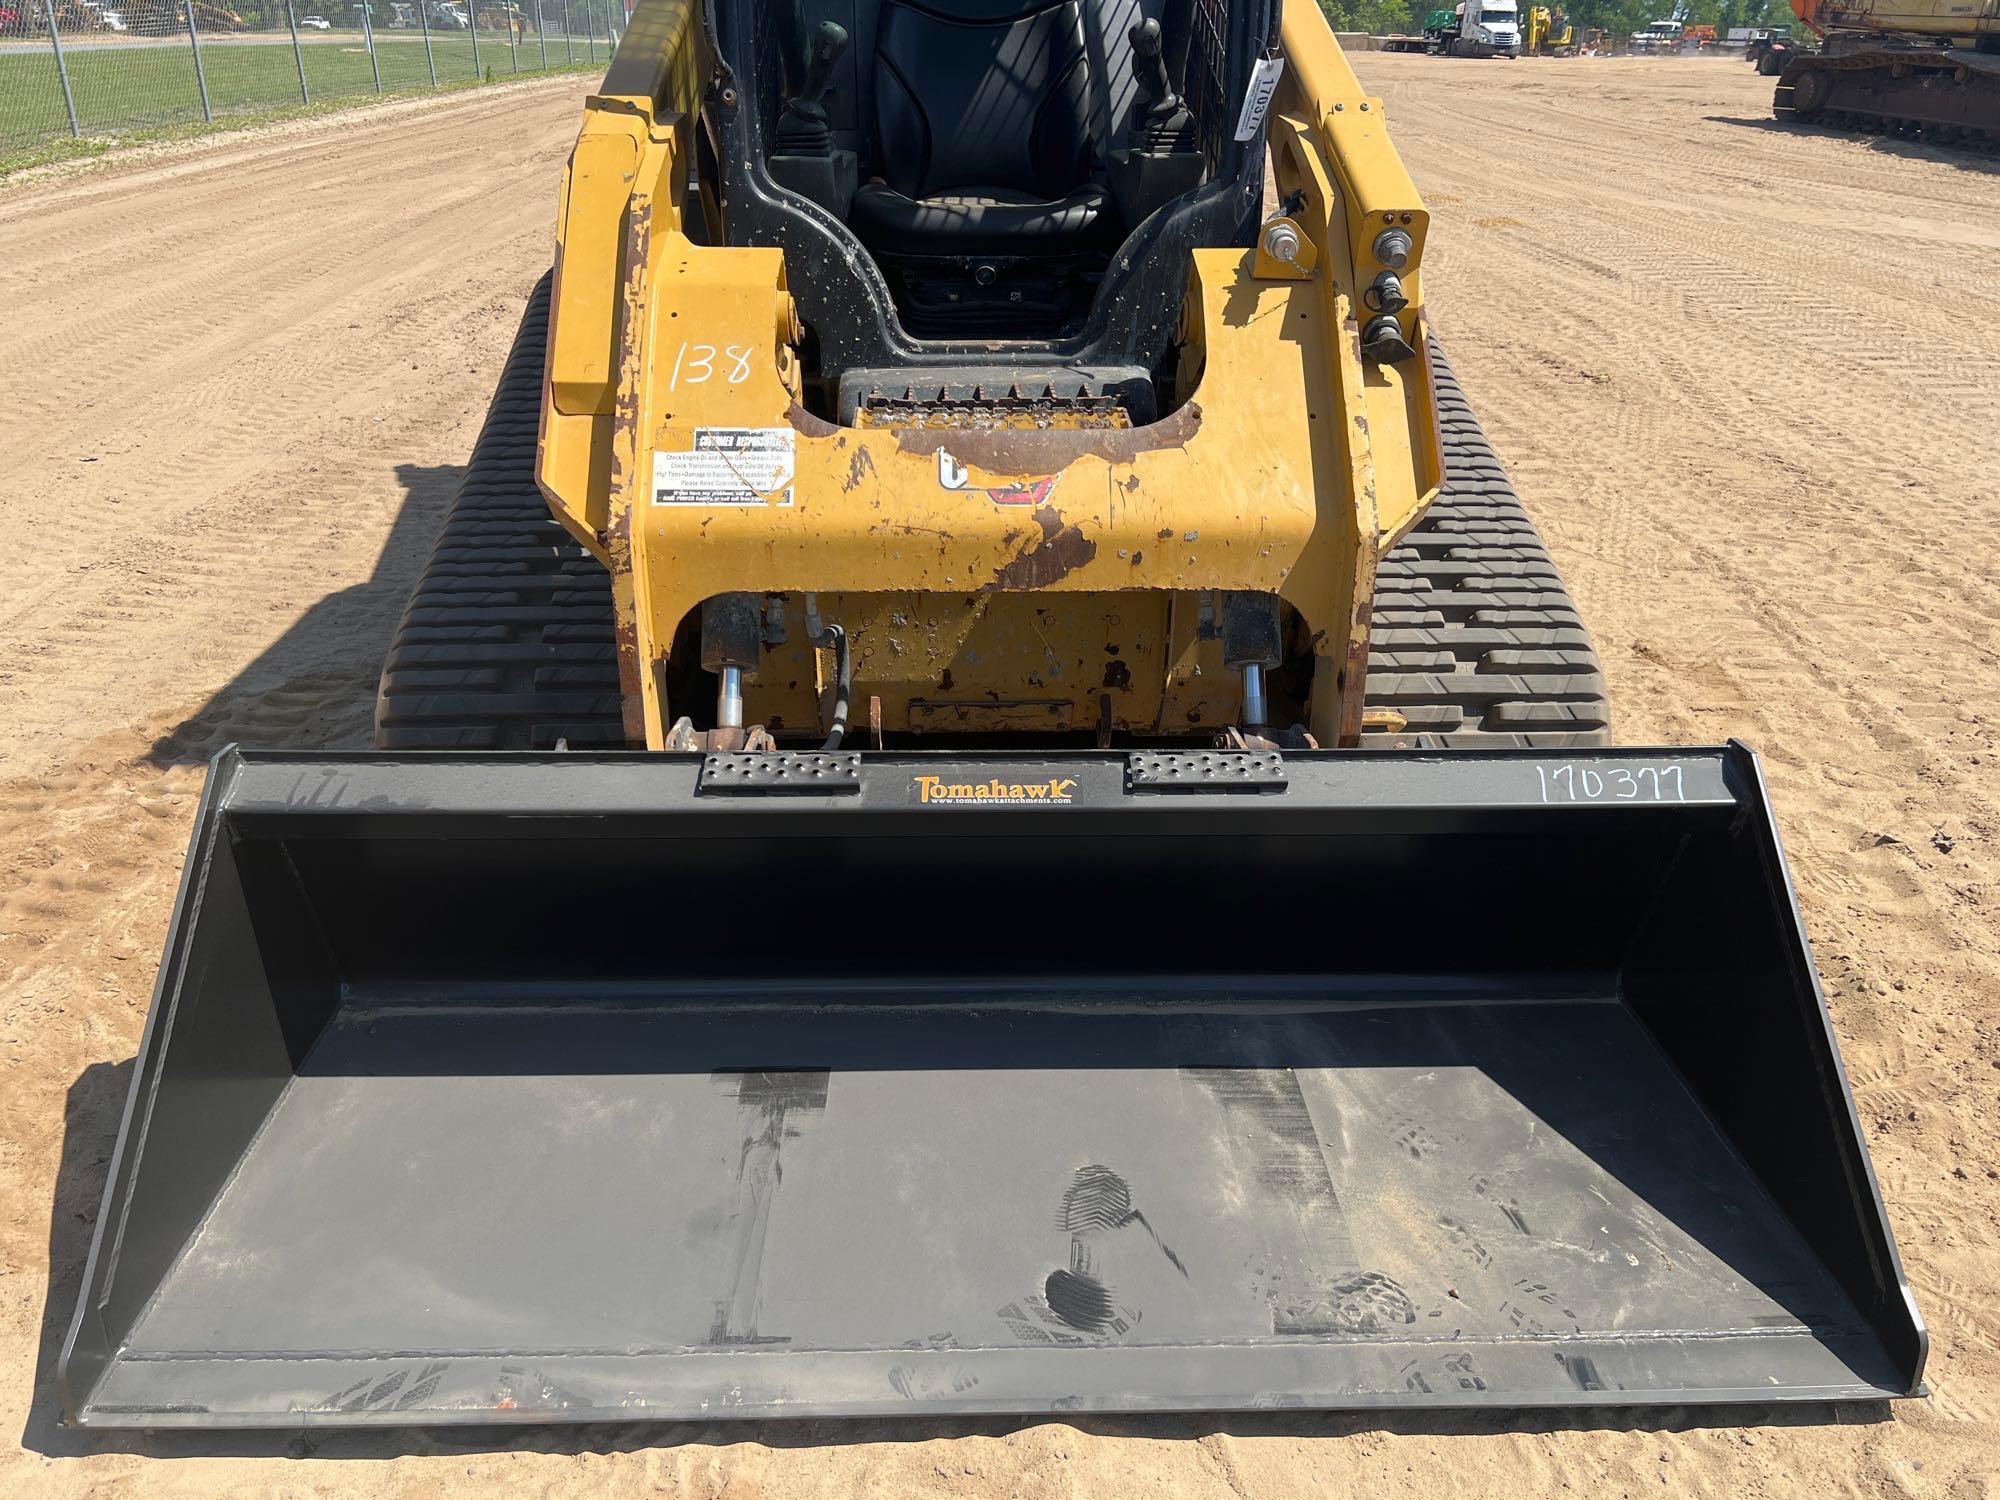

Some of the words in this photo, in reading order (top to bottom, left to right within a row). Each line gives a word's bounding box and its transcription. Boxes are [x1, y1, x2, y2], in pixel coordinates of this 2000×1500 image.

[669, 342, 753, 392] 138
[931, 797, 1072, 805] www.tomahawkattachments.com
[1536, 764, 1686, 804] 170377
